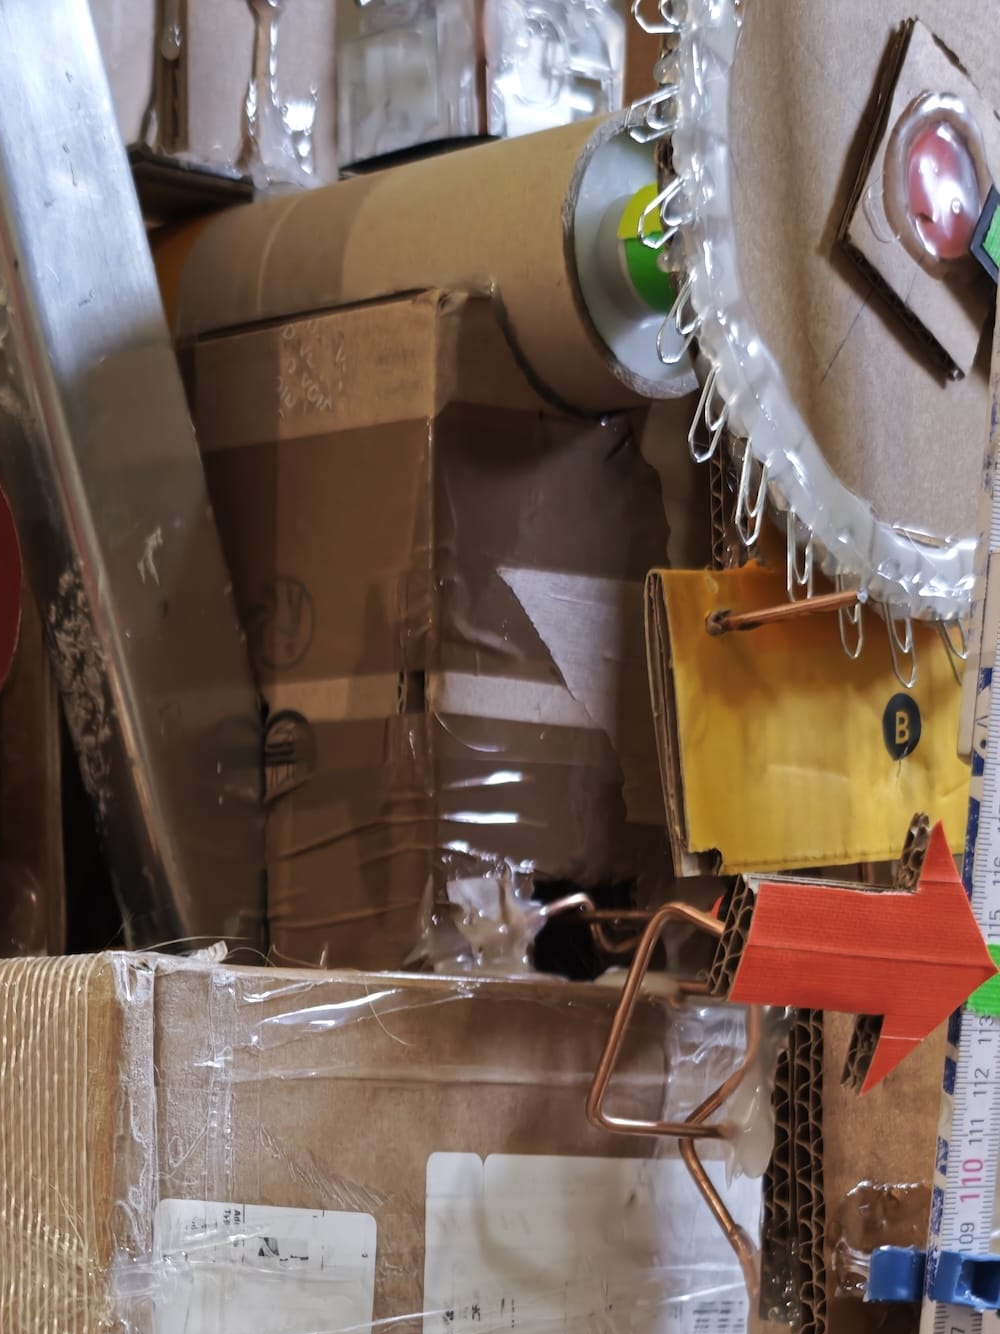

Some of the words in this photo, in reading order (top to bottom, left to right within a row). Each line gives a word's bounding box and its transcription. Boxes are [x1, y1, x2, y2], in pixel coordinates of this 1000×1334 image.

[894, 711, 911, 744] B
[972, 1067, 991, 1097] 112
[967, 1118, 987, 1145] 111
[958, 1158, 985, 1204] 110
